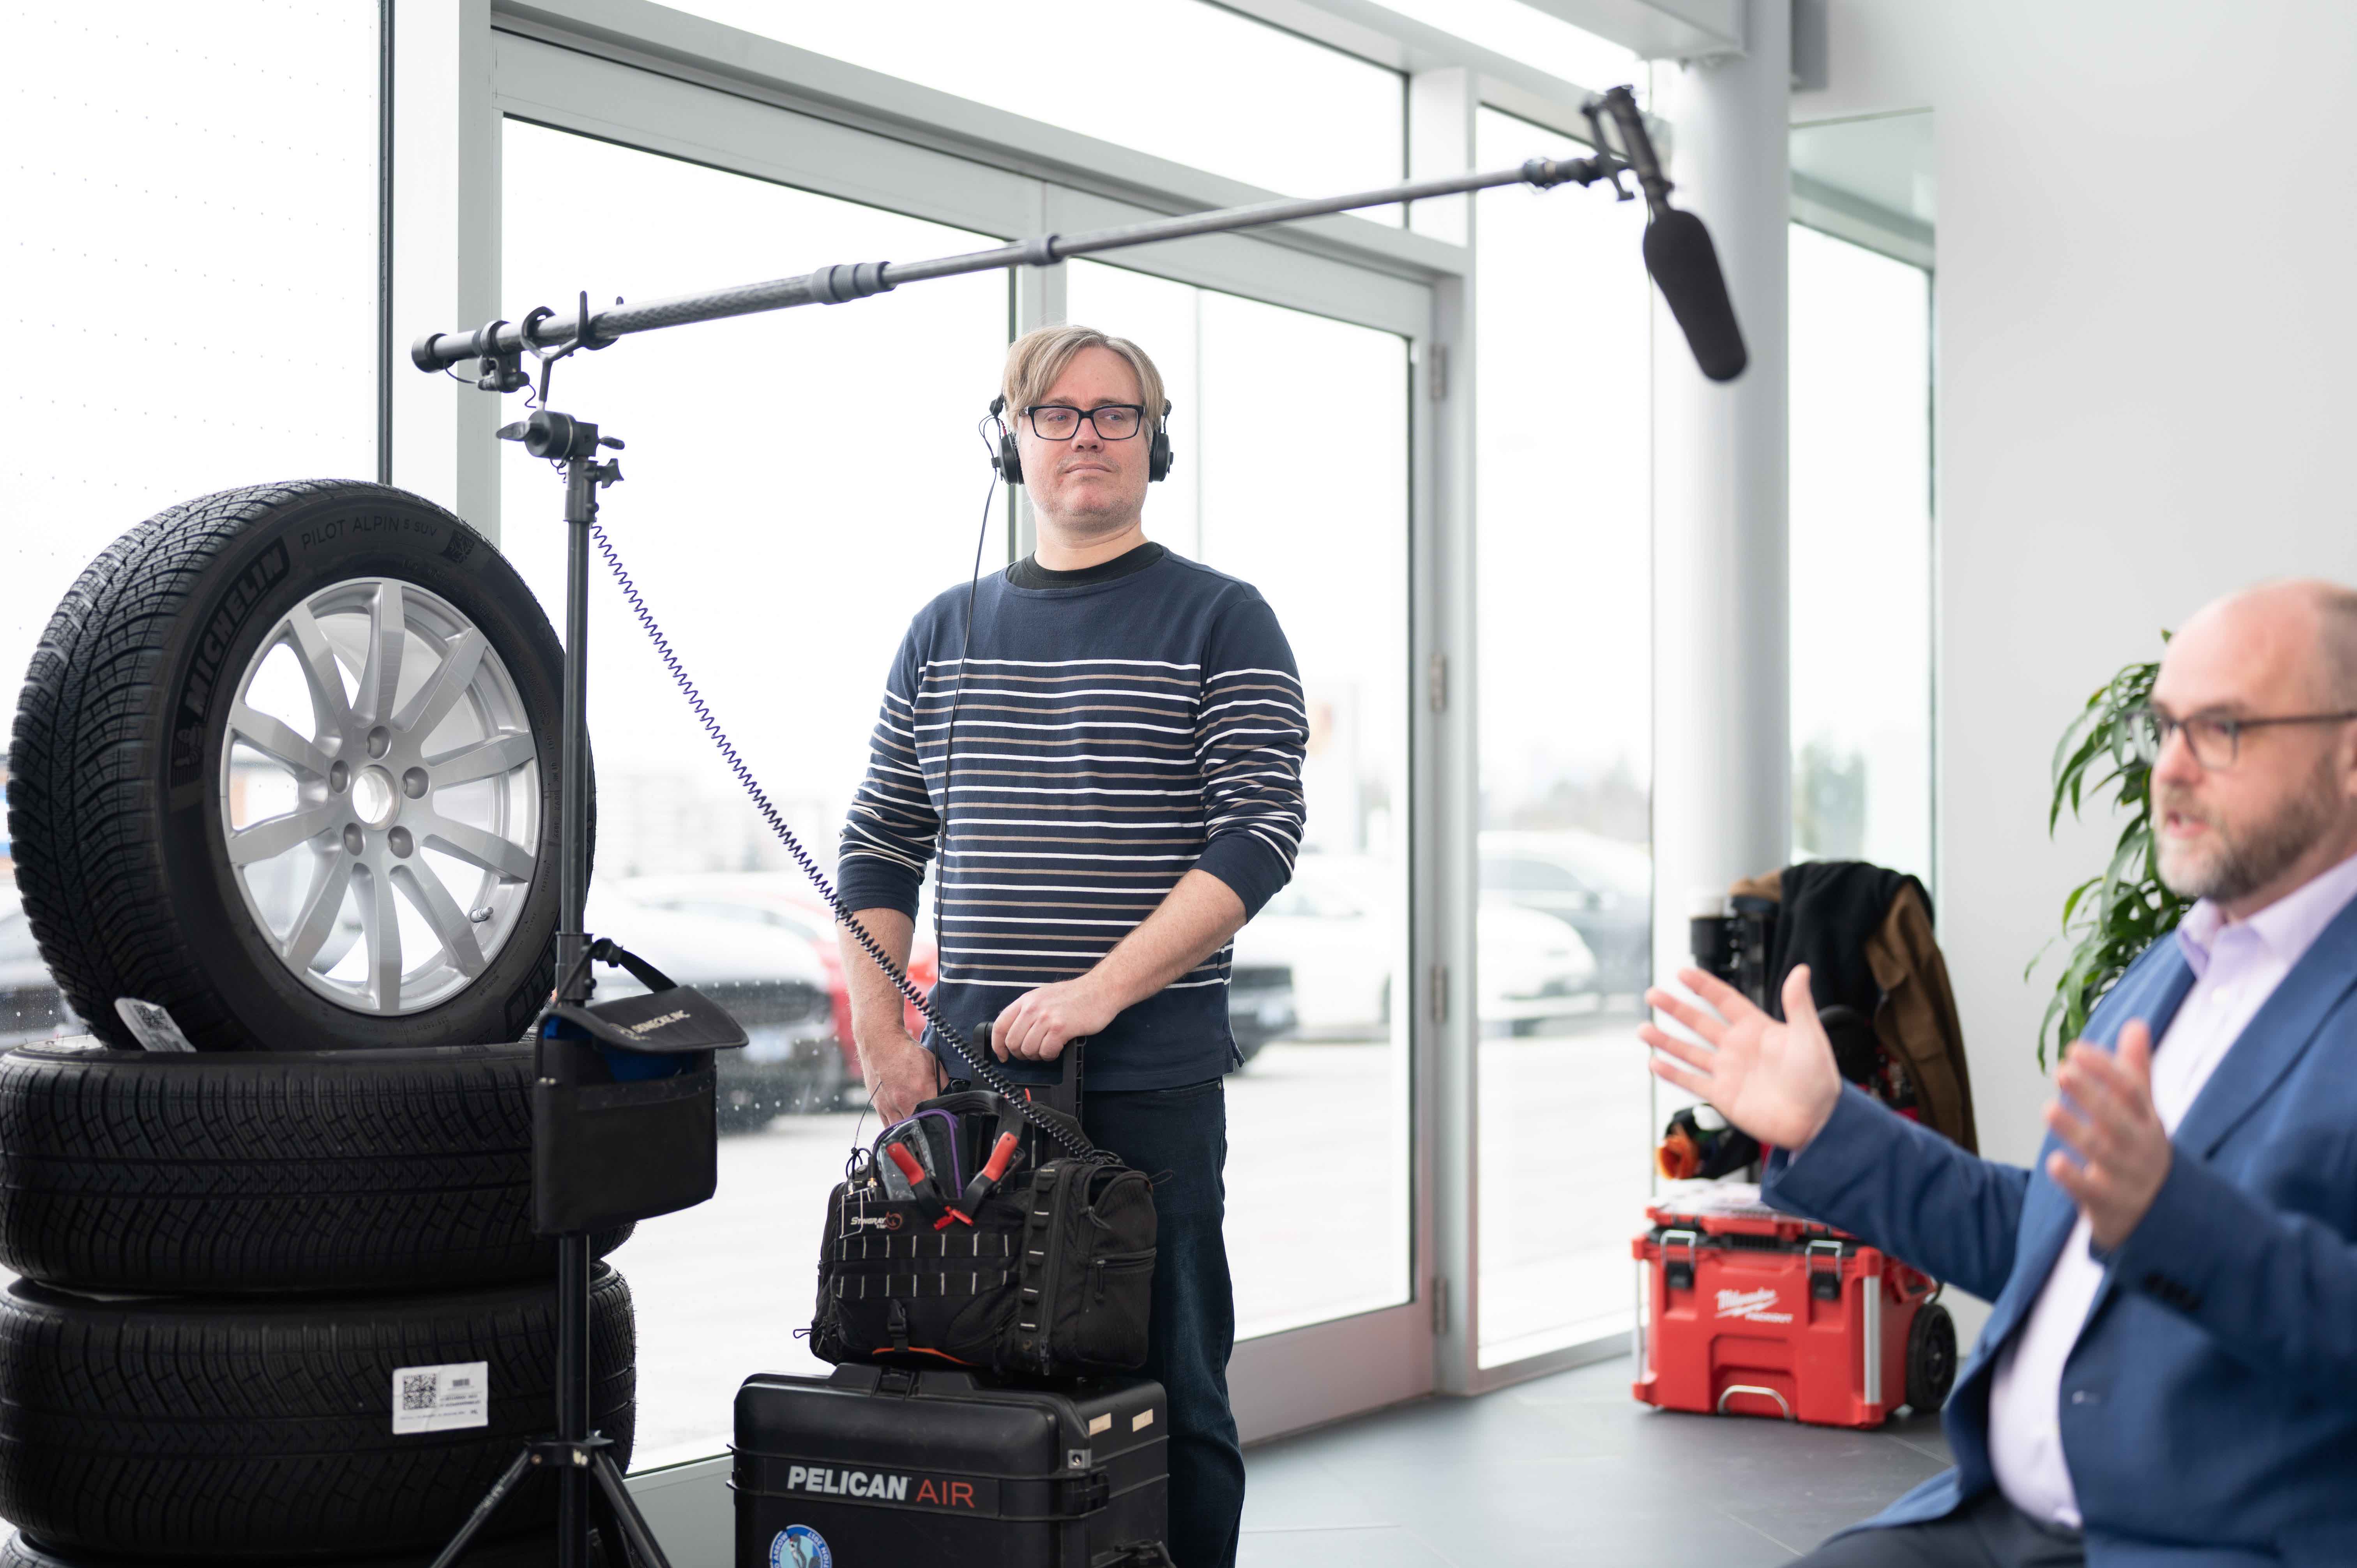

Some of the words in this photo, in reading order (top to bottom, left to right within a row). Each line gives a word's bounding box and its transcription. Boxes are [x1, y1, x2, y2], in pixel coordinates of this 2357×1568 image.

[301, 519, 346, 550] PILOT
[352, 516, 399, 532] ALPIN
[414, 521, 438, 537] SUV
[185, 546, 284, 716] MICHELIN
[850, 1216, 887, 1226] STNGRAY
[787, 1465, 908, 1501] PELICAN
[916, 1479, 975, 1508] AIR
